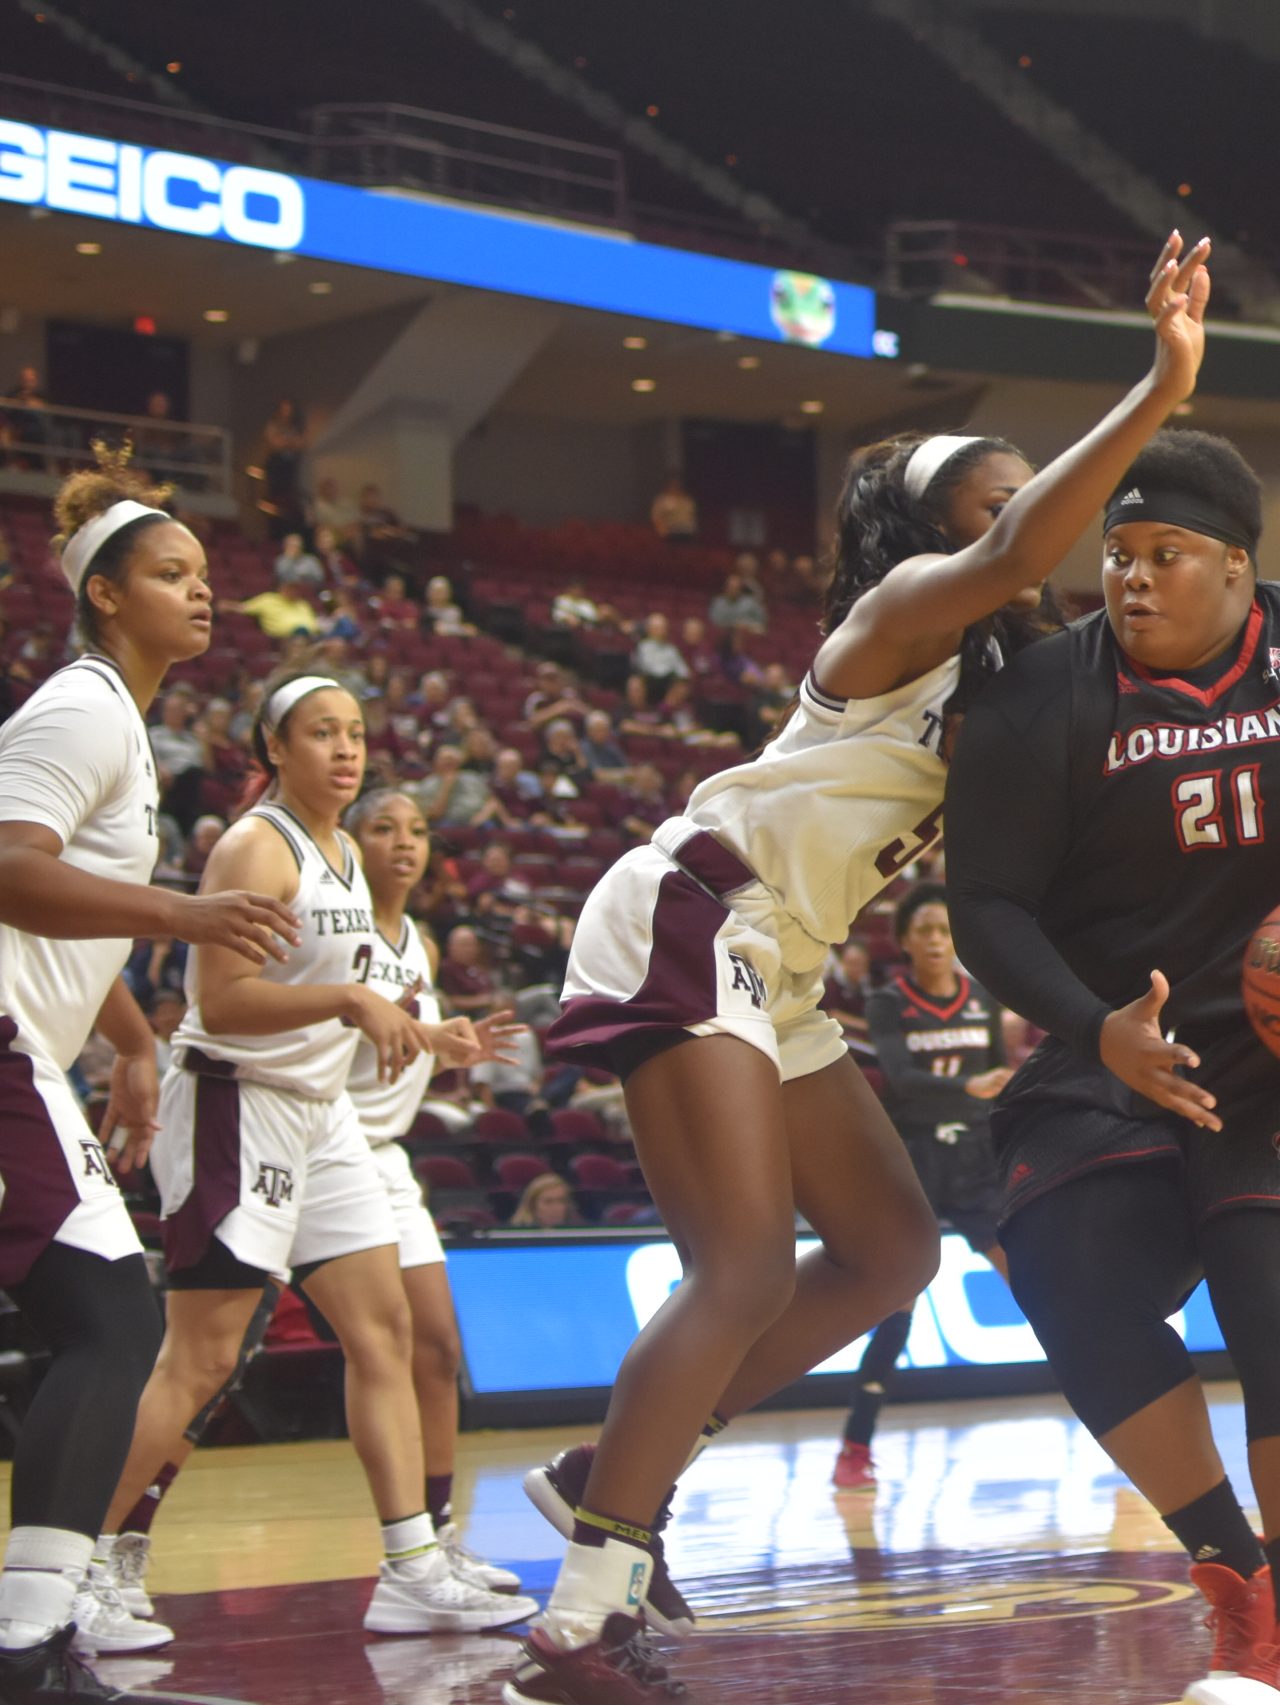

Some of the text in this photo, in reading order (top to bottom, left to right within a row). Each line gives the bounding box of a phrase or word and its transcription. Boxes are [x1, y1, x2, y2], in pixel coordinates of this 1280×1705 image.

[0, 118, 304, 250] GEICO
[1171, 763, 1264, 853] 21
[312, 908, 371, 936] TEXAS
[370, 960, 416, 988] EXAS
[906, 1027, 990, 1052] OUISIANA
